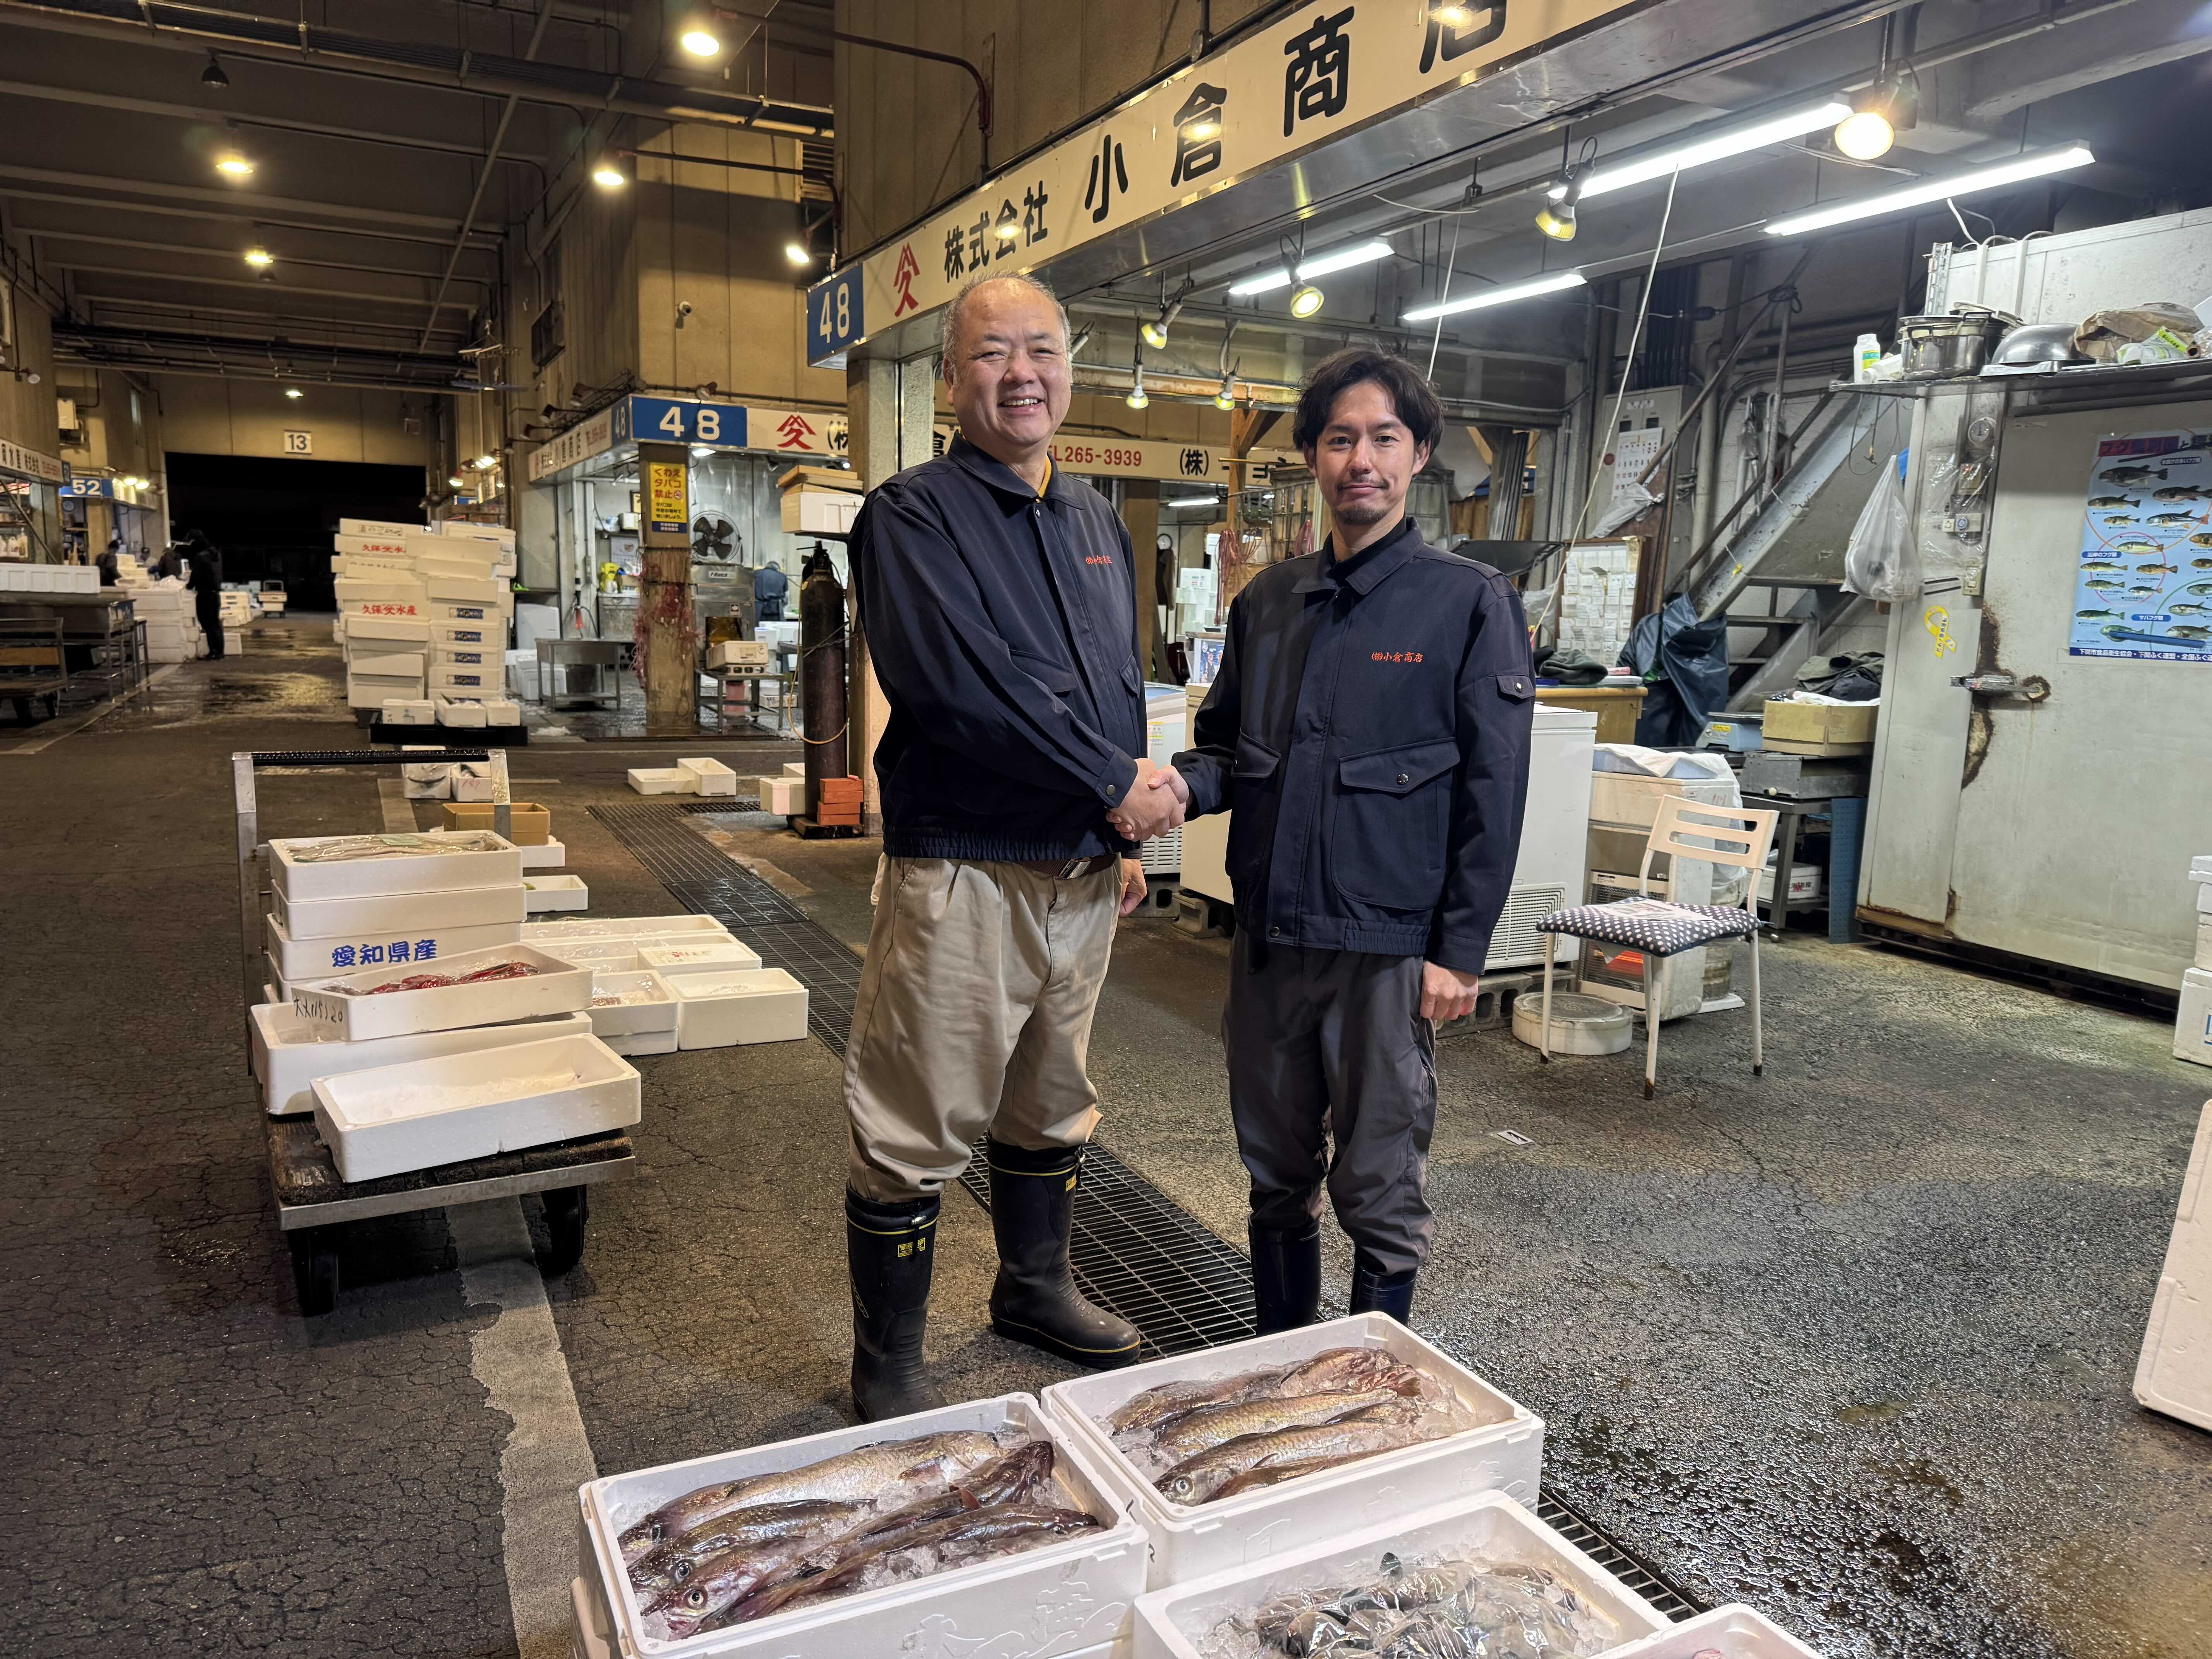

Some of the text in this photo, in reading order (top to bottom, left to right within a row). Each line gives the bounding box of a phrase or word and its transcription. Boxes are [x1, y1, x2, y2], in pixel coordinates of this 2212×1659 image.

[818, 283, 850, 342] 48
[944, 181, 1049, 283] 株式会社
[660, 406, 720, 440] 48
[289, 434, 307, 450] 13
[1180, 448, 1209, 477] (株)
[654, 468, 682, 477] くわえ
[72, 479, 101, 495] 52
[654, 479, 682, 488] タバコ
[654, 489, 673, 499] 禁止
[332, 939, 437, 967] 愛知県産
